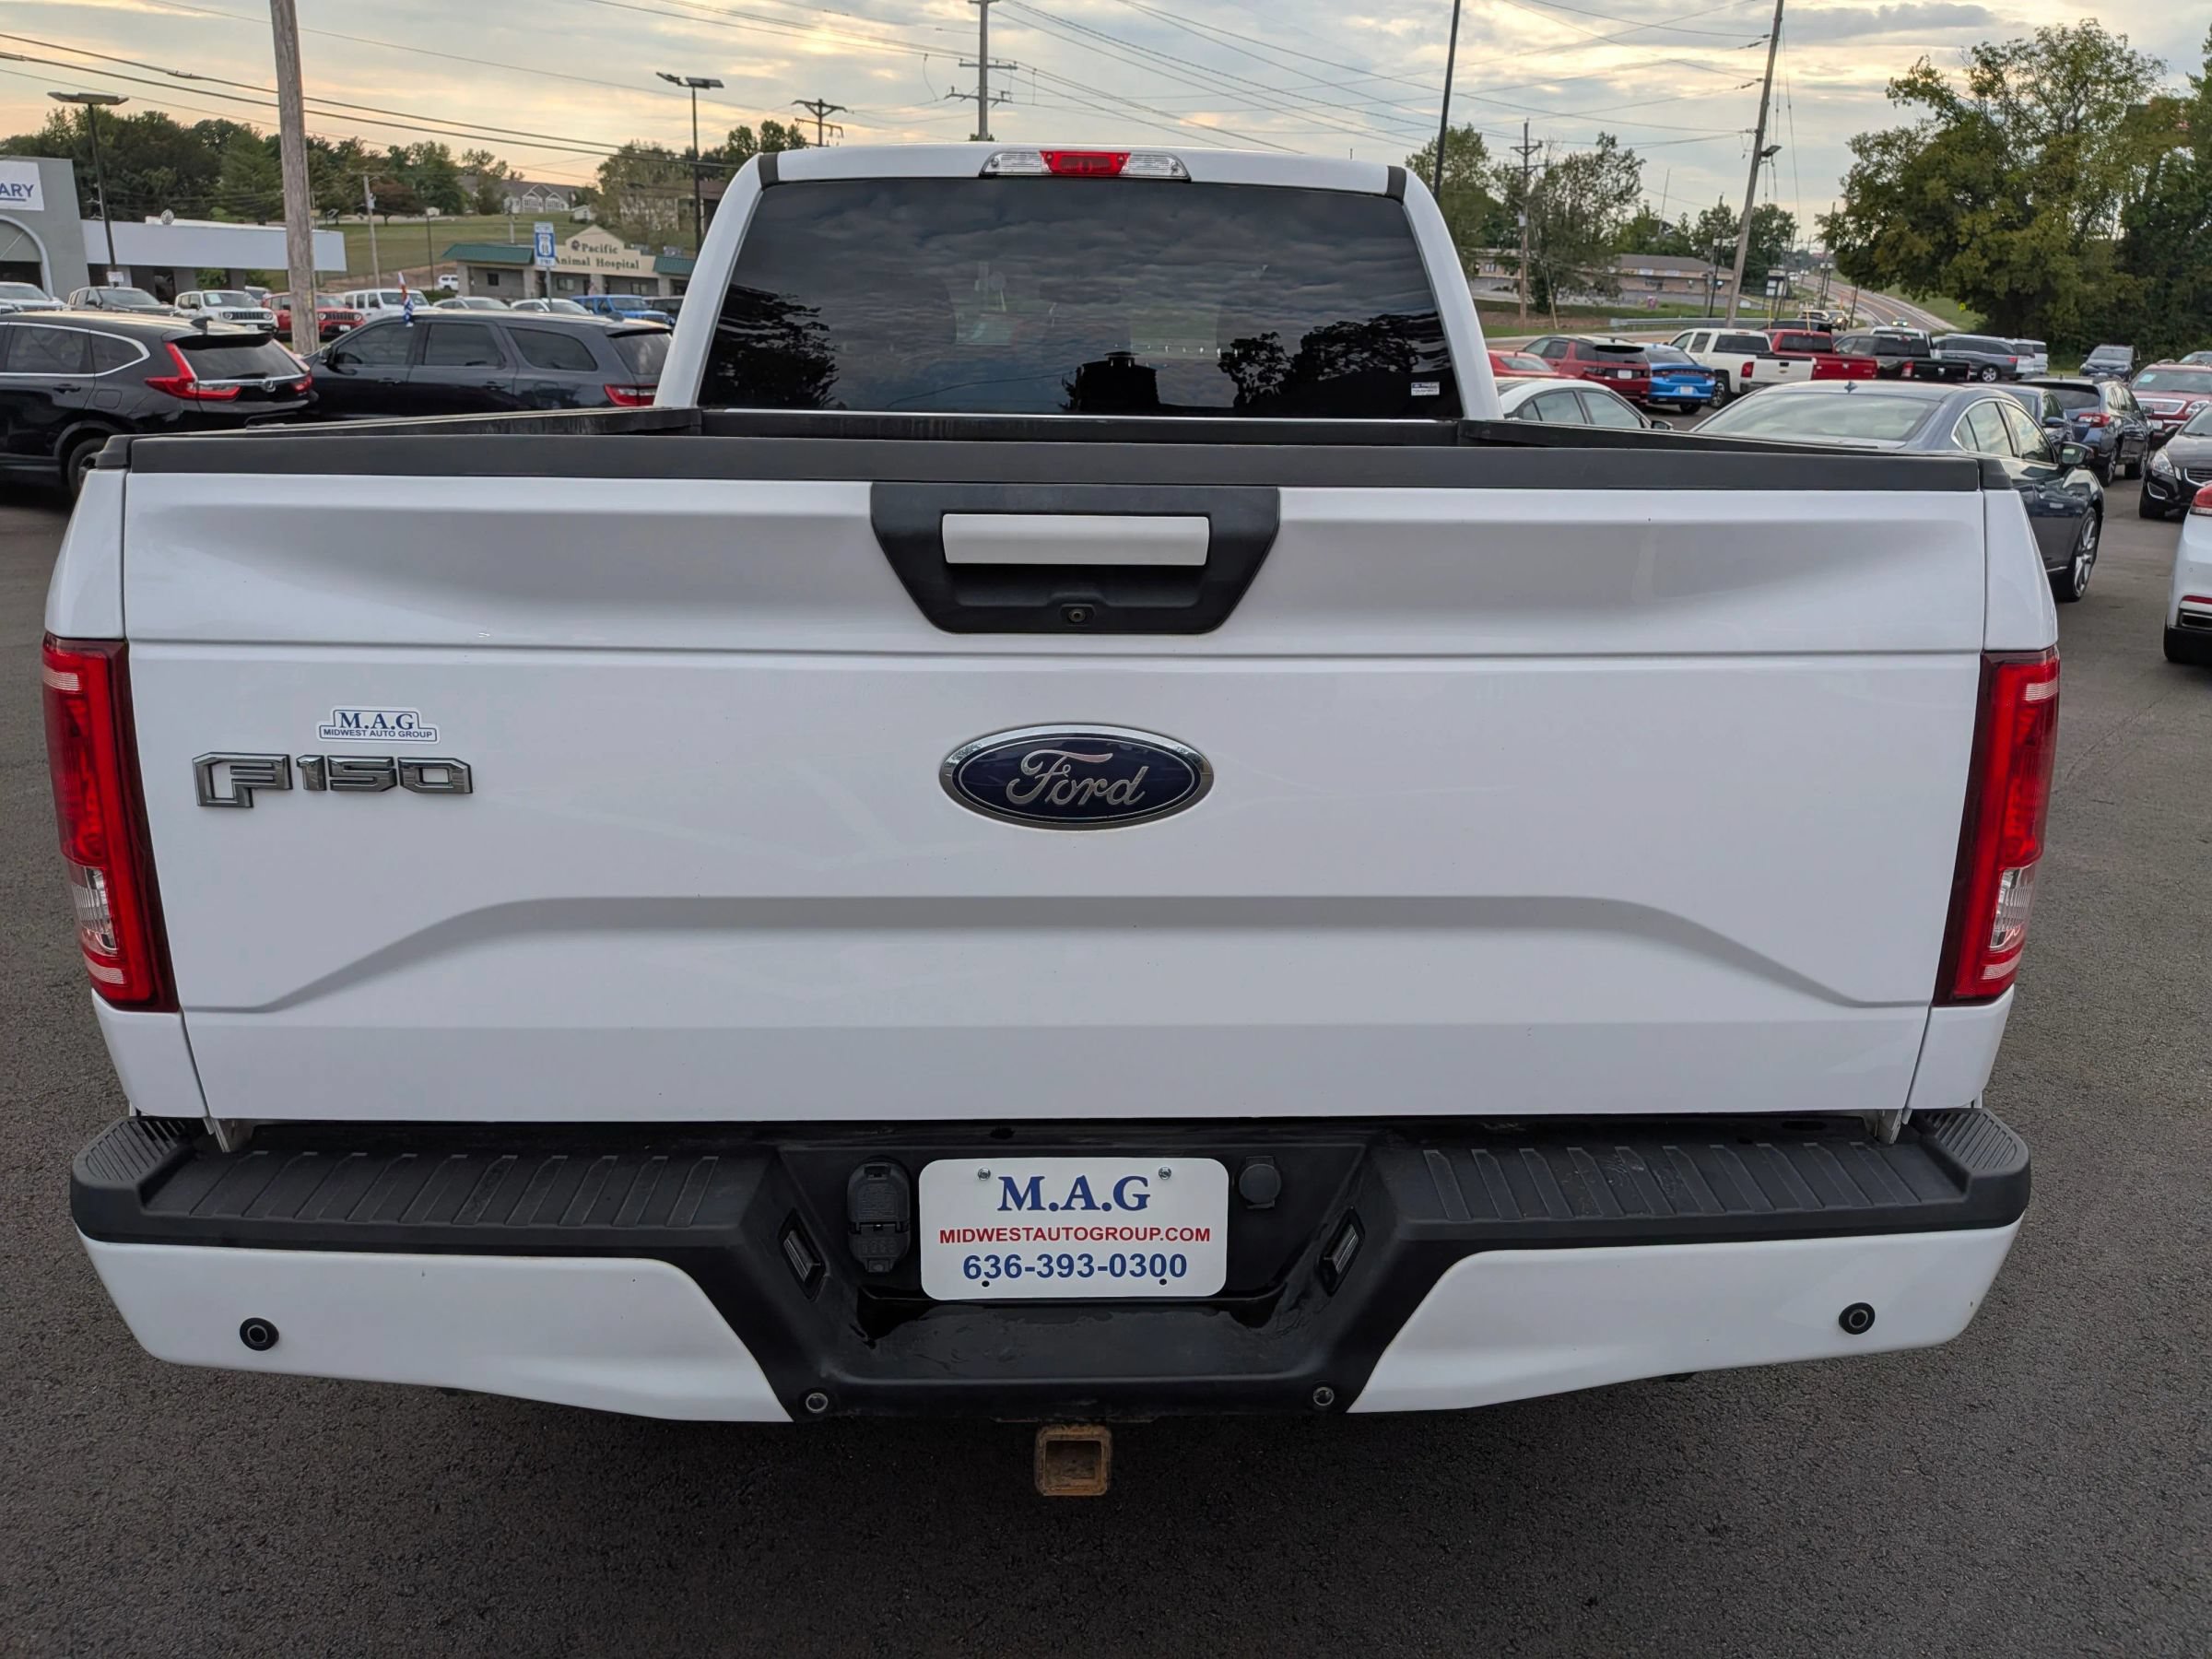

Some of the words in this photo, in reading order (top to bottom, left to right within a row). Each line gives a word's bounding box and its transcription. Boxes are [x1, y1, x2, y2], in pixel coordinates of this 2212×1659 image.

[582, 242, 618, 254] Pacific
[596, 259, 640, 270] Hospital
[338, 712, 415, 730] M.A.G
[324, 728, 367, 737] MIDWEST
[370, 729, 396, 738] AUTO
[1006, 748, 1149, 806] Ford
[997, 1174, 1151, 1213] M.A.G
[939, 1226, 1211, 1244] MIDWESTAUTOGROUP.COM
[963, 1253, 1188, 1280] 636-393-0300
